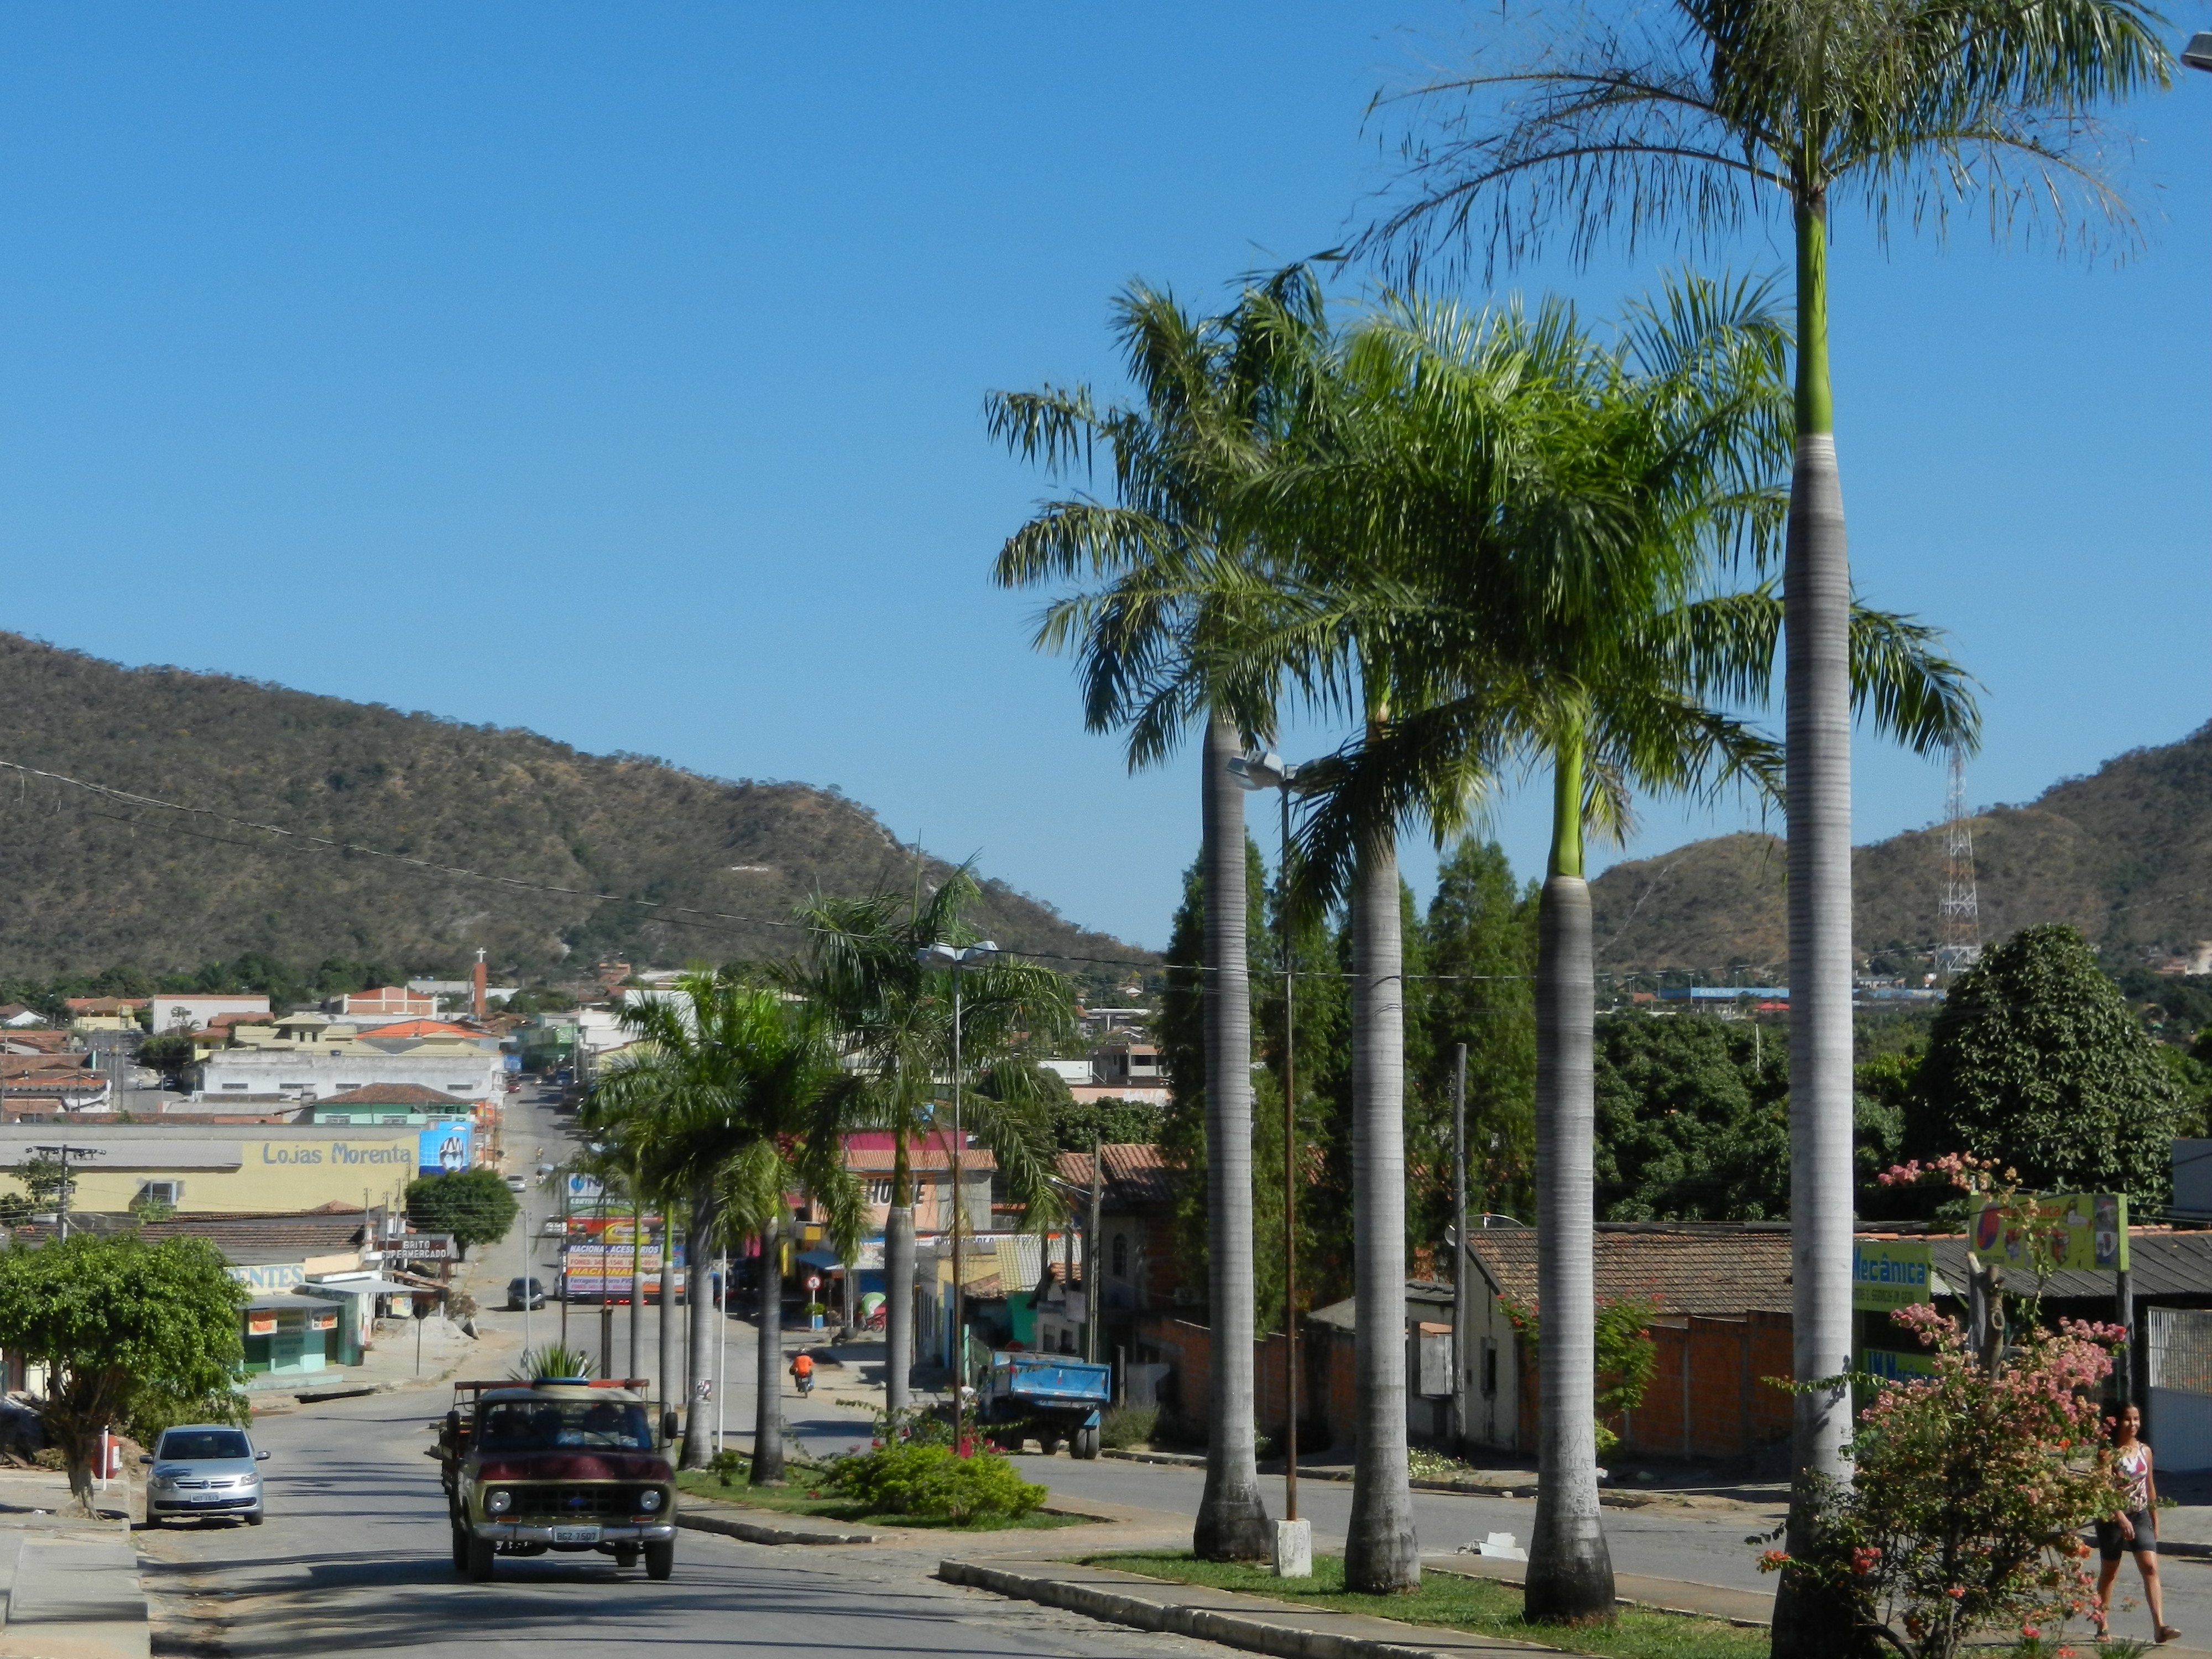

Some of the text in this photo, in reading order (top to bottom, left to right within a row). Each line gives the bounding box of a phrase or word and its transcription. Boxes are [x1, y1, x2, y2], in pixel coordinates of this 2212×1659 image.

[263, 1142, 413, 1164] Lojas Morenta
[403, 1240, 430, 1249] BRITO
